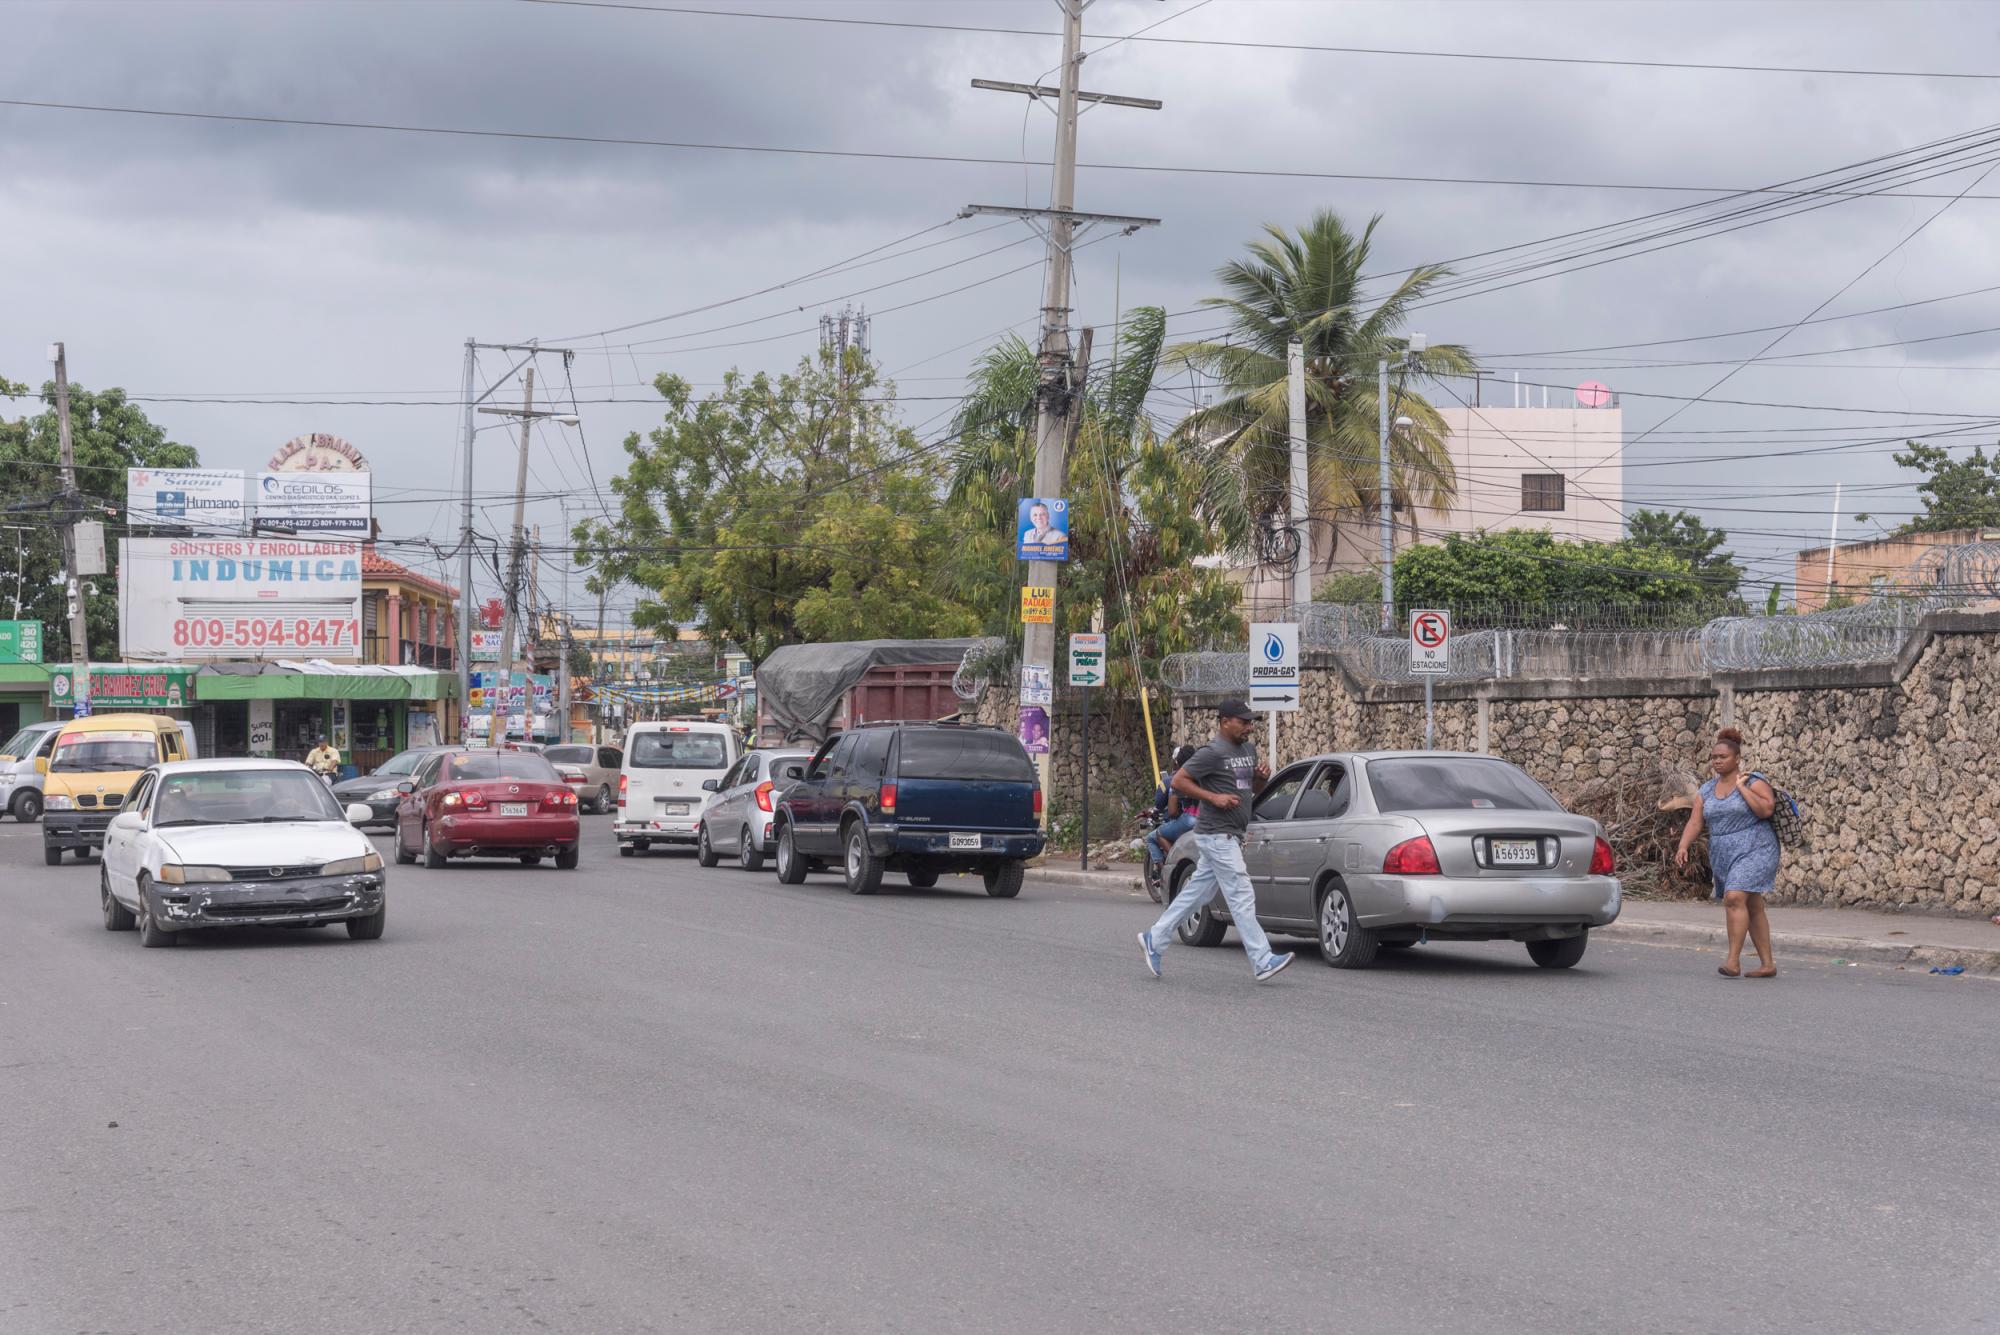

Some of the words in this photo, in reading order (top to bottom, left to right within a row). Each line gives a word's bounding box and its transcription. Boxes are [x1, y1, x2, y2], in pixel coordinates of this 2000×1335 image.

[186, 496, 240, 509] Humano
[170, 542, 242, 557] SHUTTERS
[247, 542, 256, 556] Y
[260, 542, 357, 556] ENROLLABLES
[171, 560, 360, 582] INDUMICA
[174, 618, 360, 647] 809-594-8471
[1424, 650, 1436, 660] NO
[1412, 660, 1447, 669] ESTACIONE
[1252, 666, 1296, 678] PROPA-GAS
[103, 674, 142, 697] RAMIREZ
[143, 674, 167, 697] CRUZ
[1495, 848, 1536, 860] A569339
